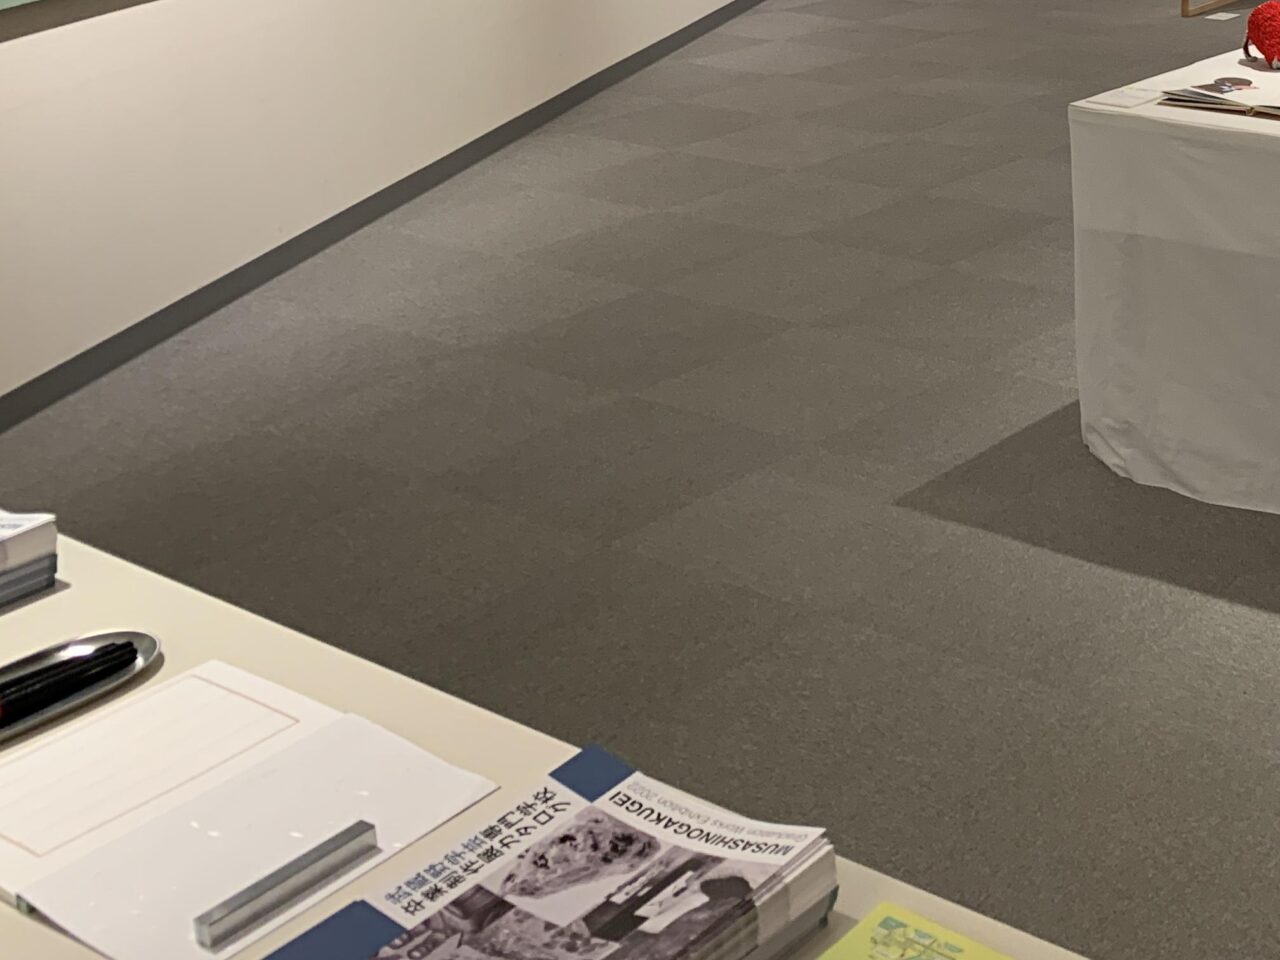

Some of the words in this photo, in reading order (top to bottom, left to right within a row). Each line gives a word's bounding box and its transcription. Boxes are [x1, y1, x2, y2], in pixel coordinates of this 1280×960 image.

[401, 801, 571, 916] 卒業制作展カタログ
[608, 791, 795, 856] MUSASHINOGAKUGEI
